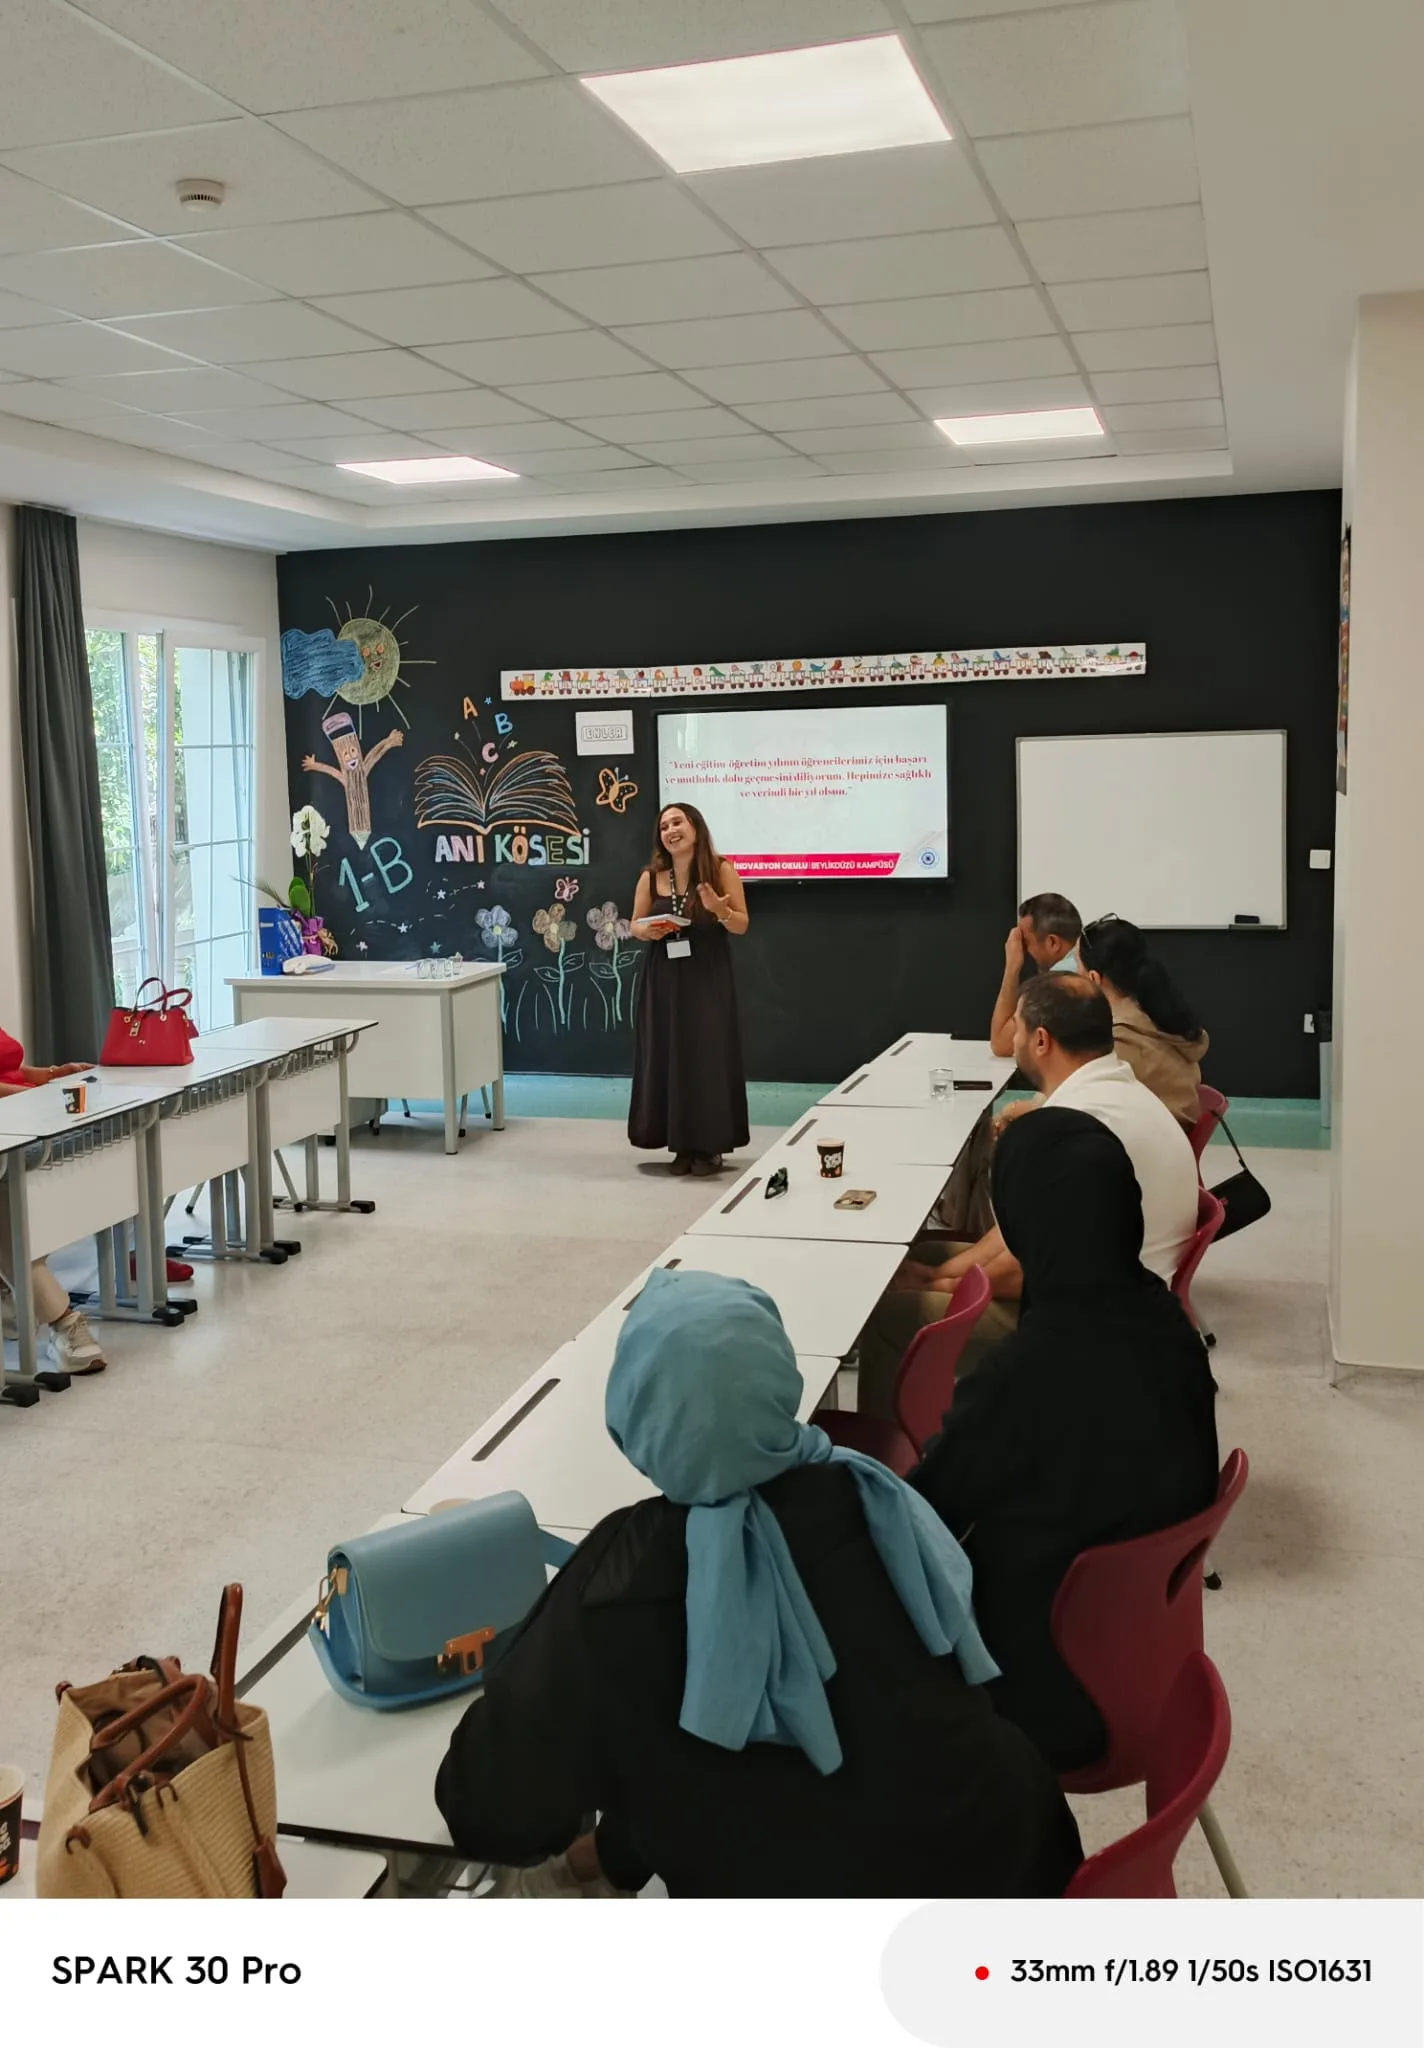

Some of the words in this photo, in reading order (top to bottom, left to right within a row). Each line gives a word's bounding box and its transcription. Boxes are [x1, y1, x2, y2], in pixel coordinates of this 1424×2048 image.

[463, 696, 478, 719] A
[495, 712, 513, 735] B
[482, 742, 499, 763] C
[435, 835, 485, 863] ANI
[338, 837, 414, 913] 1-B
